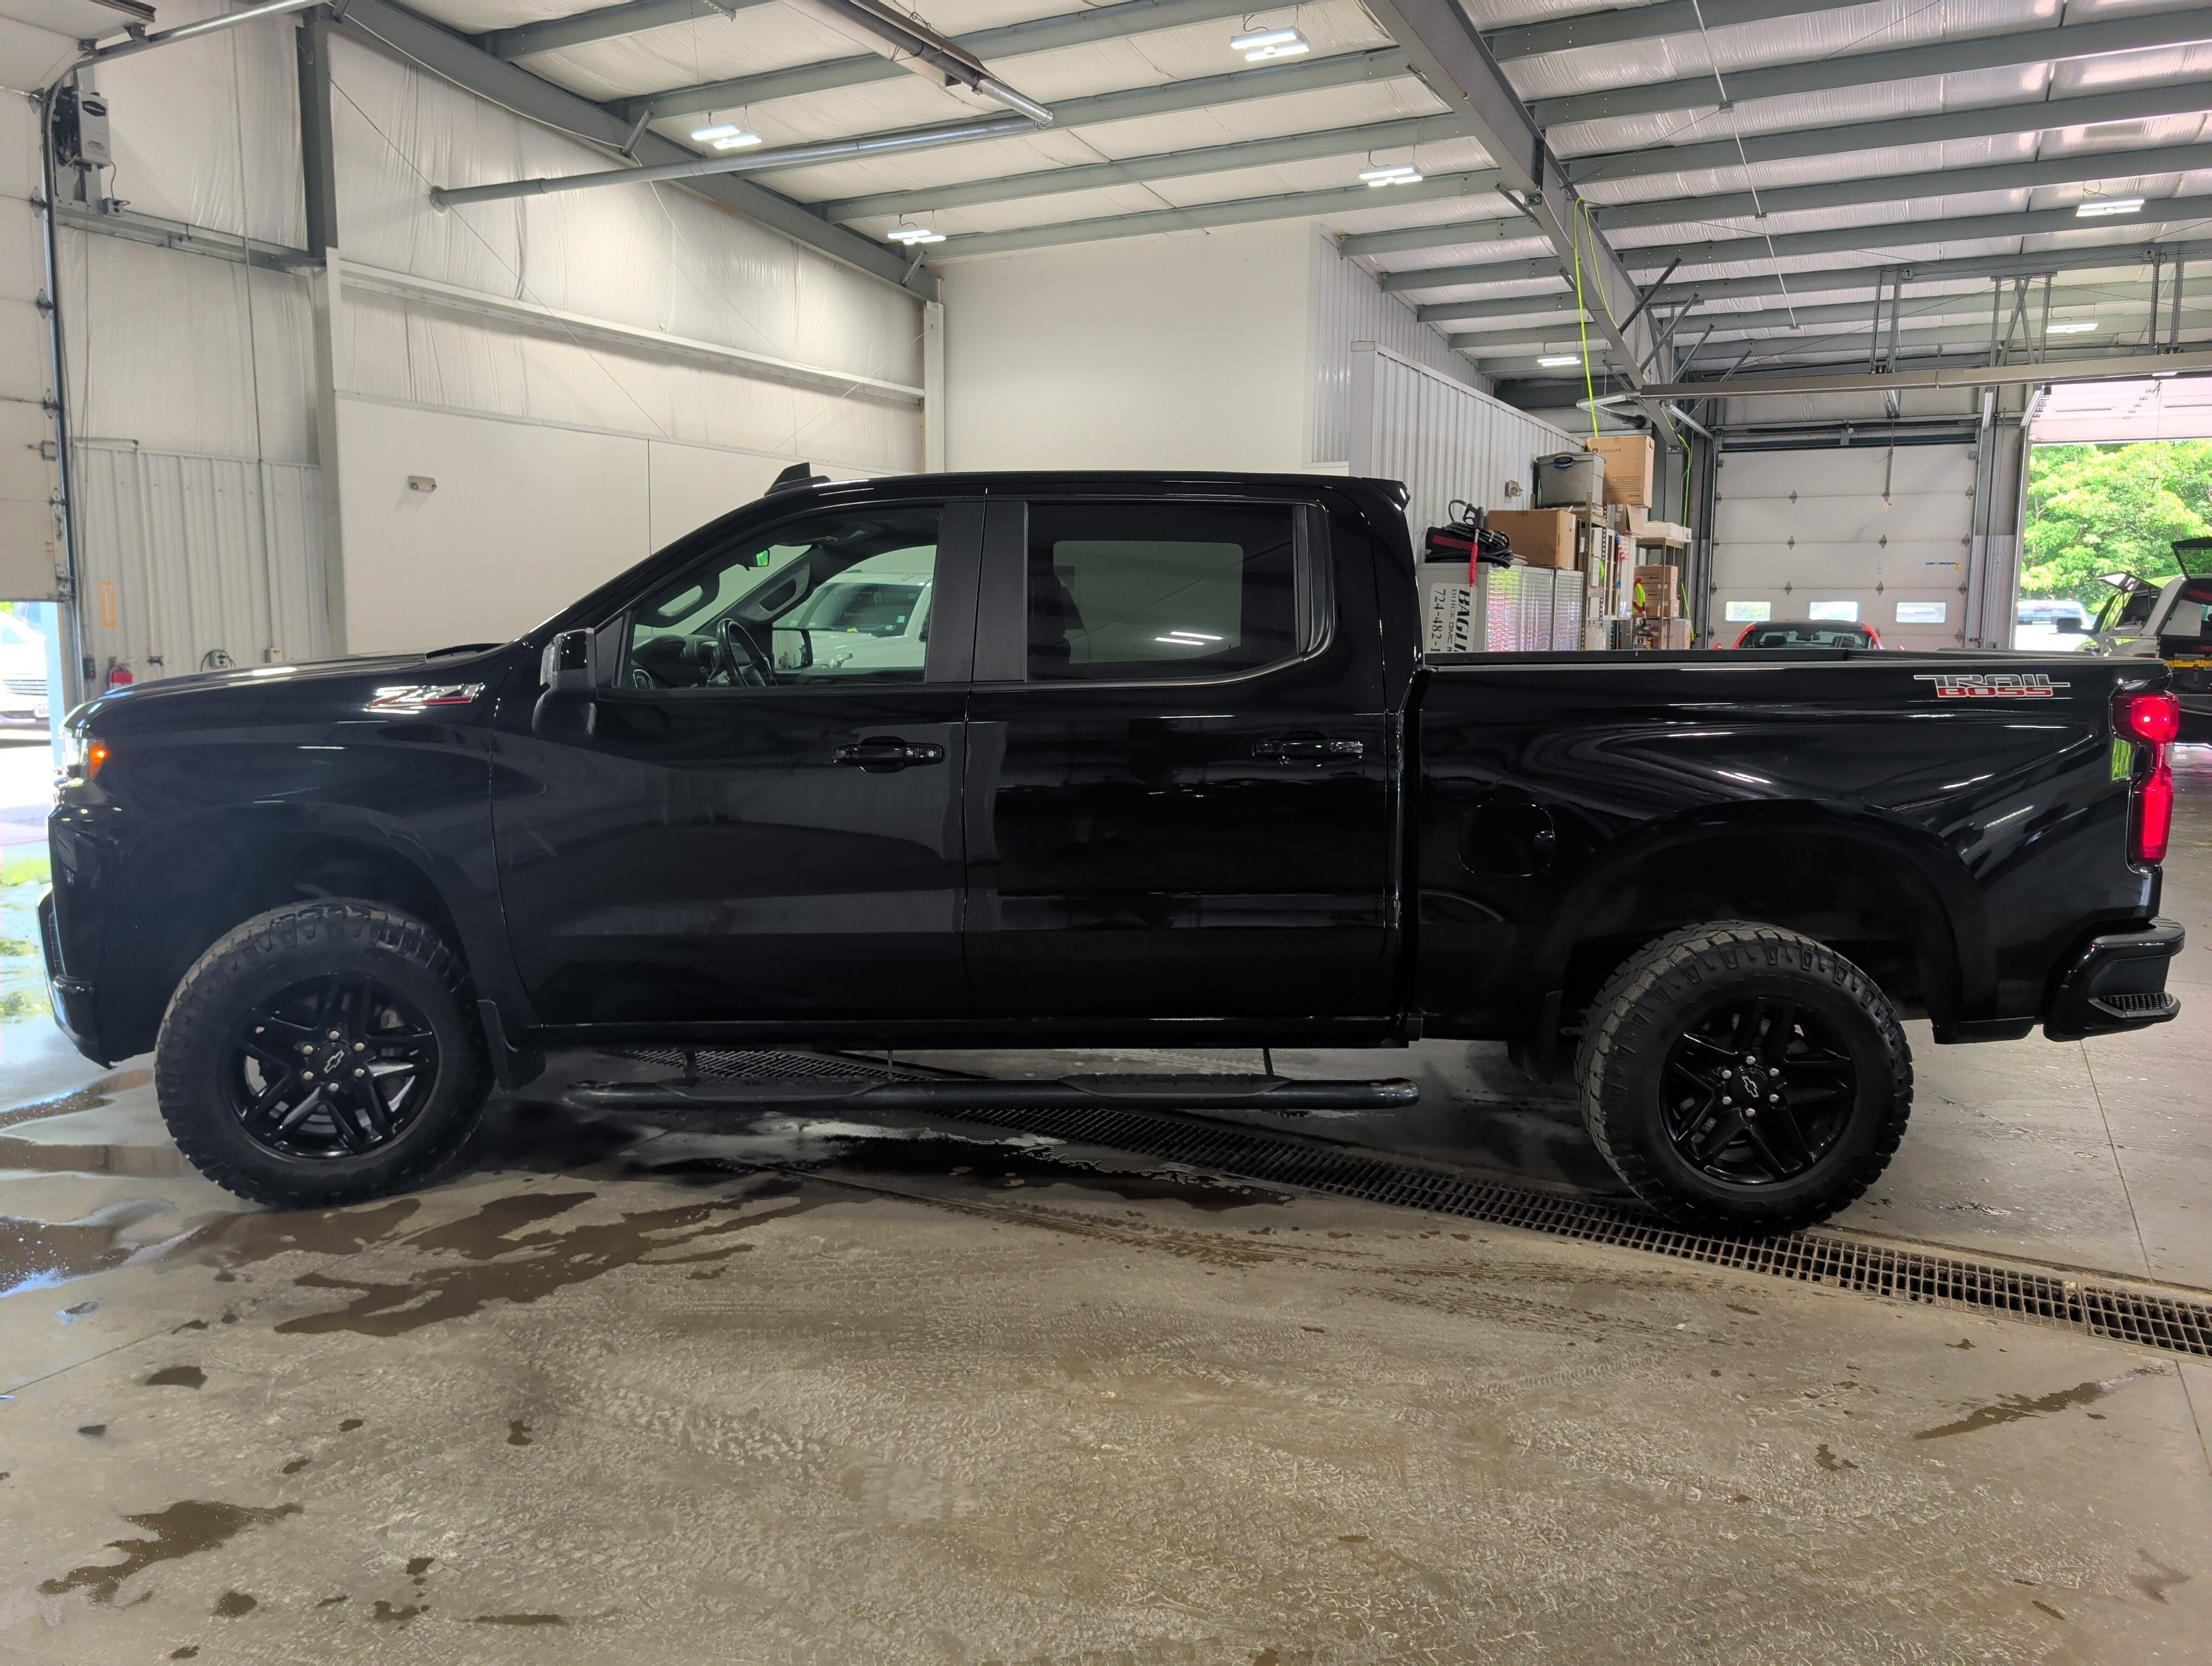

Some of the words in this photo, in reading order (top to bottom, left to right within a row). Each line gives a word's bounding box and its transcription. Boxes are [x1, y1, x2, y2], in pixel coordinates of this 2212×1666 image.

[1454, 589, 1470, 652] BAGLI
[1913, 674, 2071, 688] TRAIL
[1937, 686, 2054, 697] BOSS
